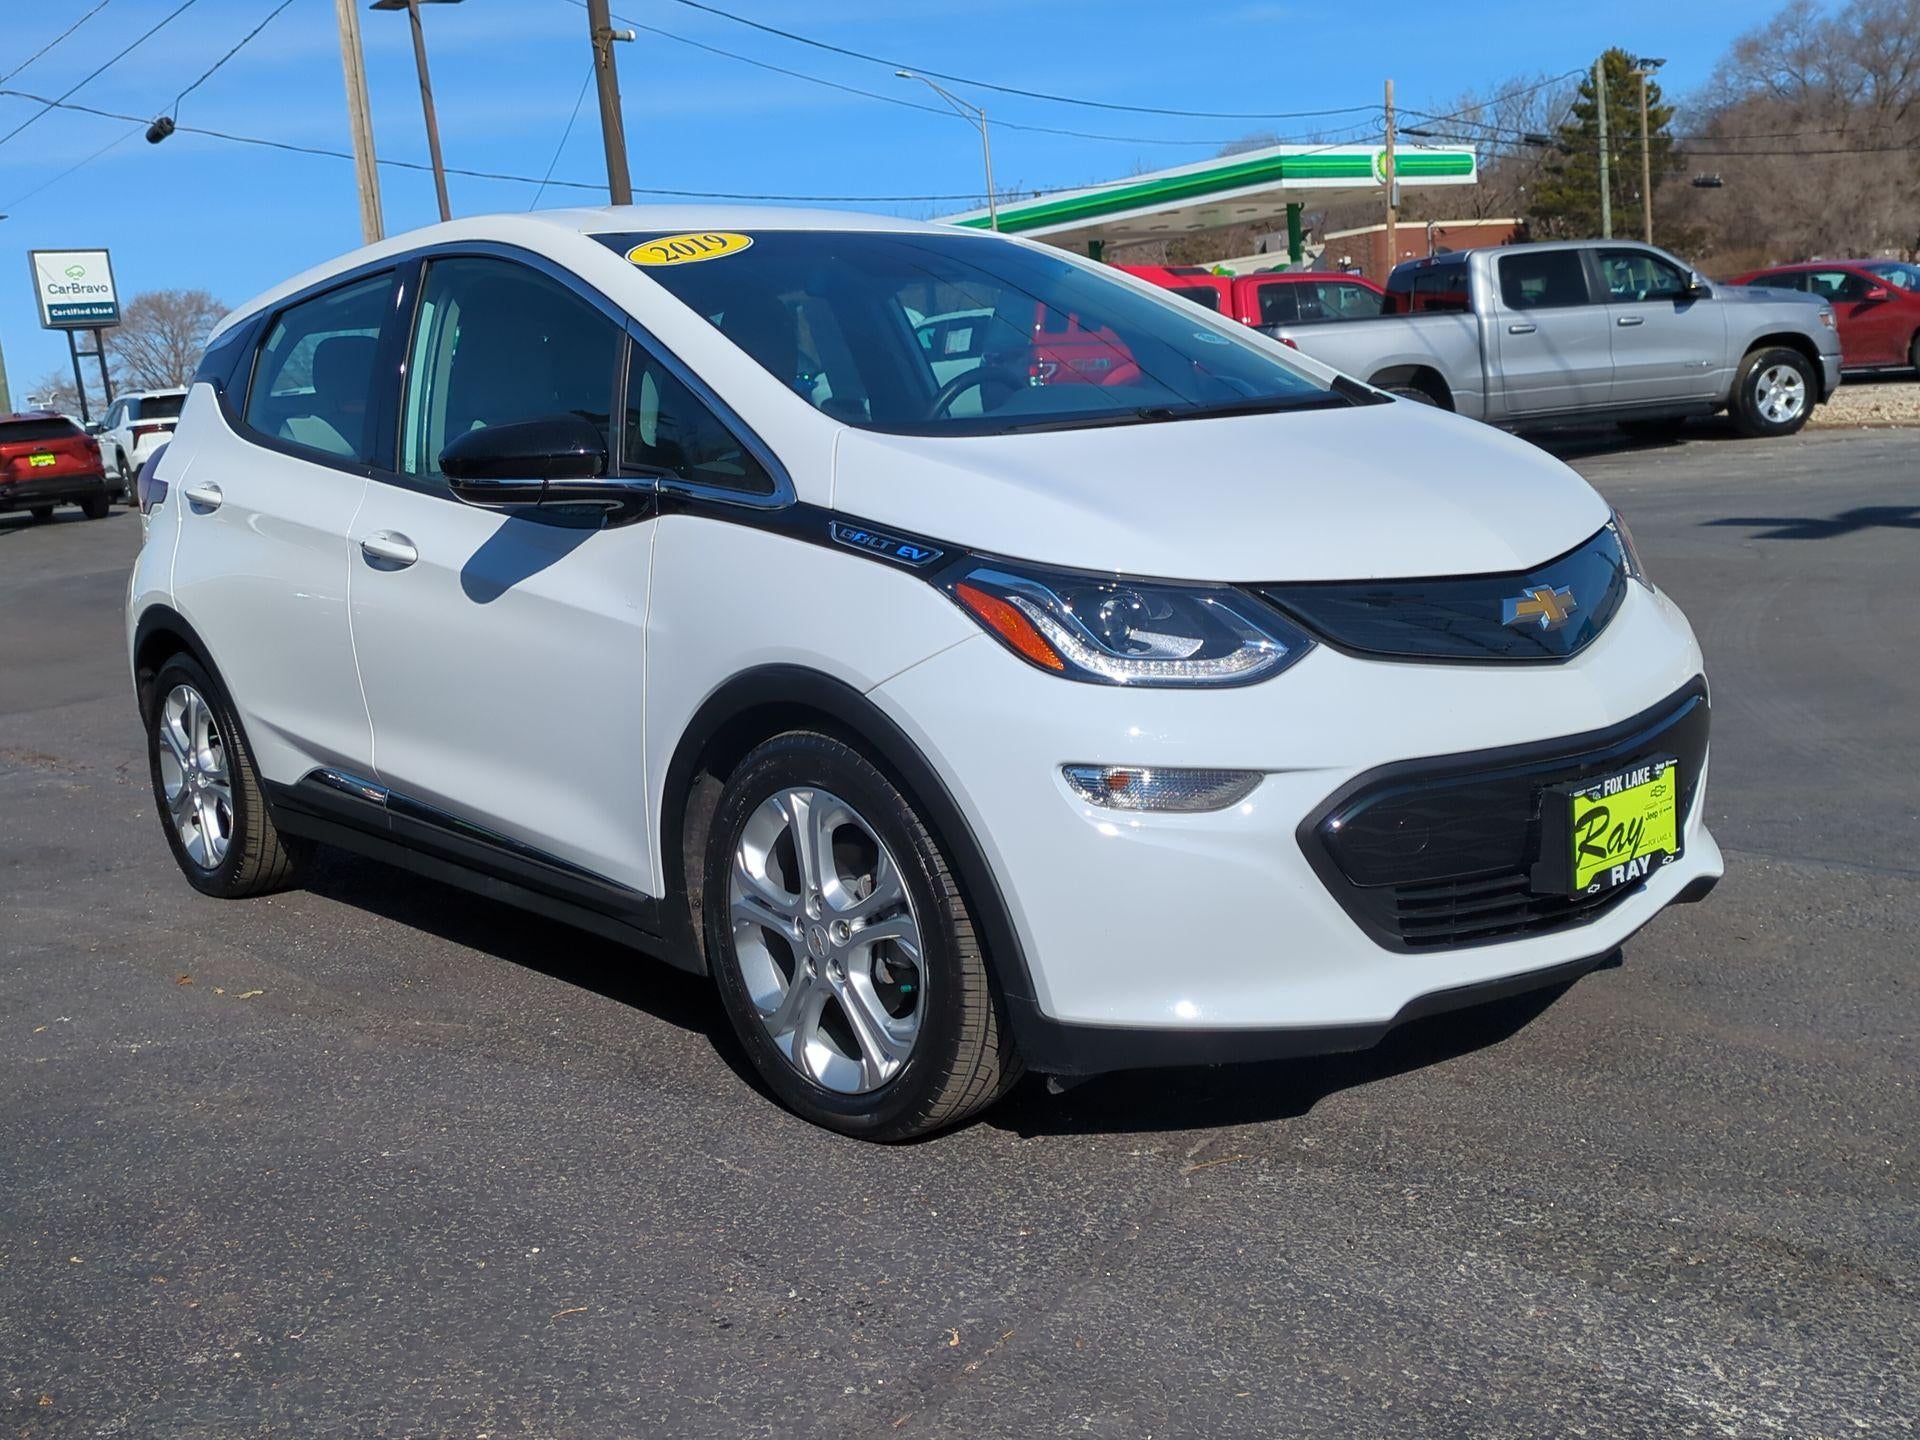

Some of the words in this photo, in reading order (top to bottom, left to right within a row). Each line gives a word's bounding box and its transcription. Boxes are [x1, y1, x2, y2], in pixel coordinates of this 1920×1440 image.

[649, 234, 728, 262] 2019
[47, 282, 109, 295] CarBravo
[52, 308, 91, 316] Certified
[91, 305, 113, 315] Used
[840, 527, 895, 550] BOLT
[896, 545, 929, 560] EV
[1604, 778, 1623, 796] FOX
[1625, 766, 1650, 790] LAKE
[1574, 805, 1645, 870] Ray
[1611, 854, 1651, 886] RAY
